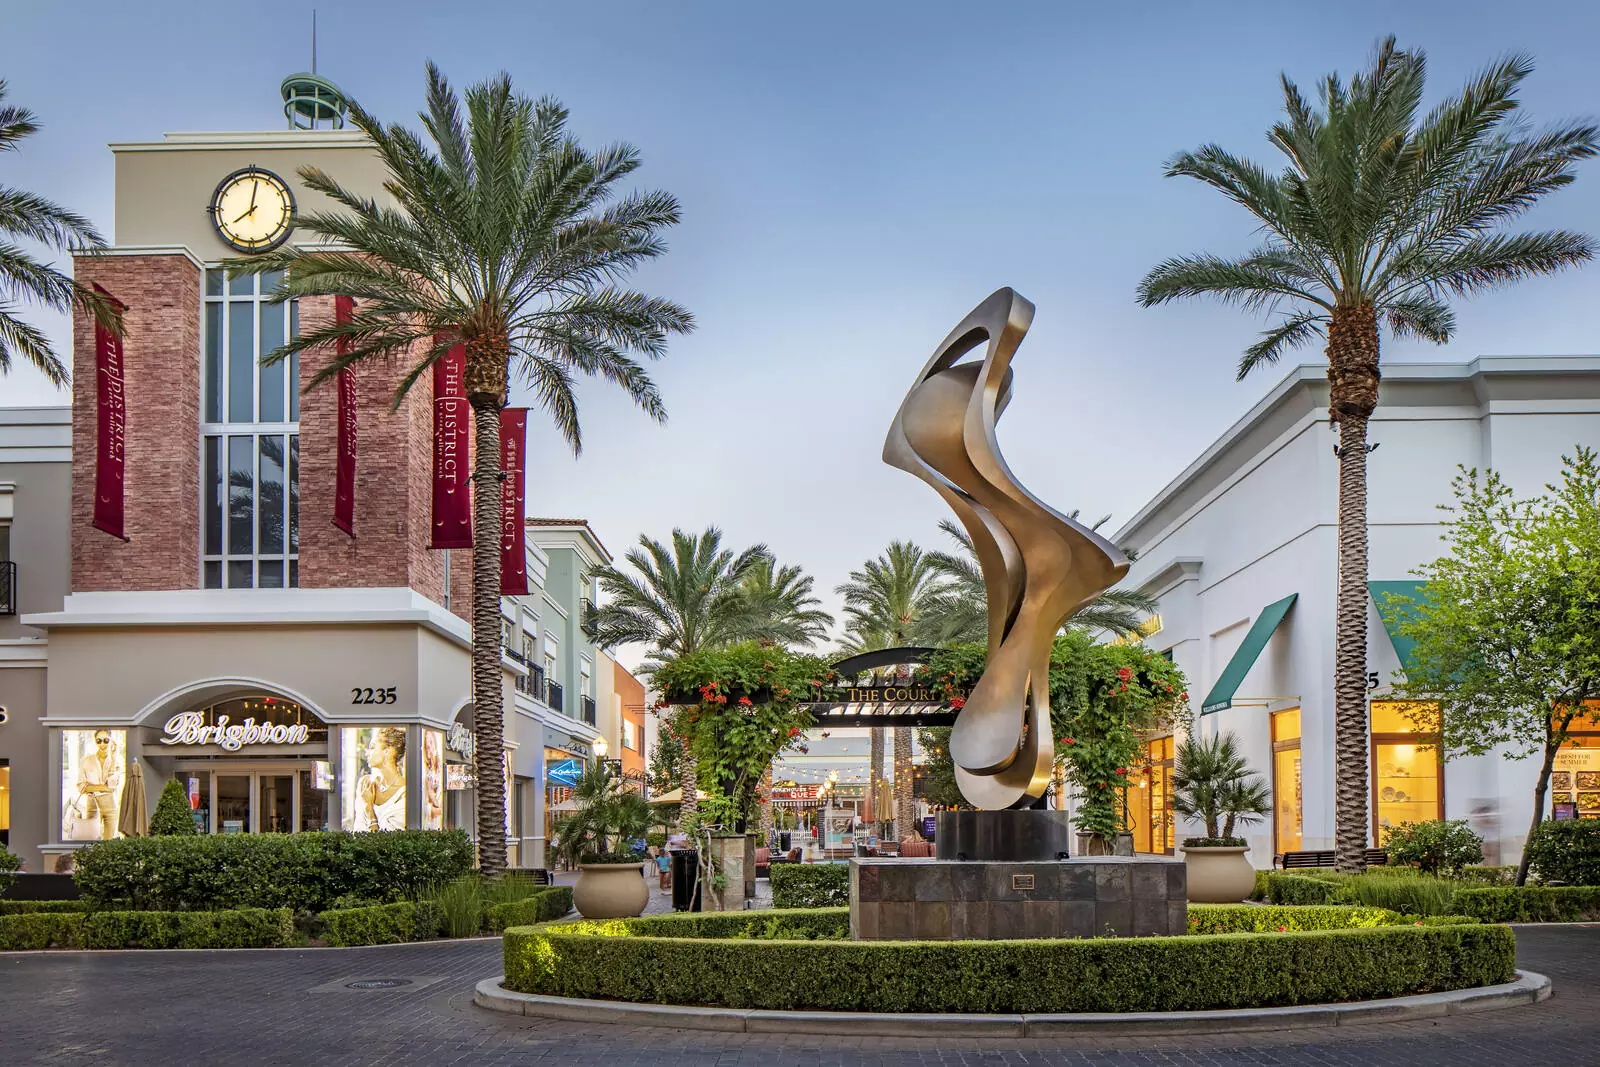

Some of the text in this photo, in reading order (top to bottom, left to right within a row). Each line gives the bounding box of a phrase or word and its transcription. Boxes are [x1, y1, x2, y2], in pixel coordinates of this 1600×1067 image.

[106, 341, 124, 463] THE DISTRICT
[445, 363, 458, 485] THE DISTRICT
[505, 473, 516, 543] DISTRICT
[351, 687, 397, 705] 2235
[847, 687, 880, 702] THE
[160, 710, 309, 752] Brighton
